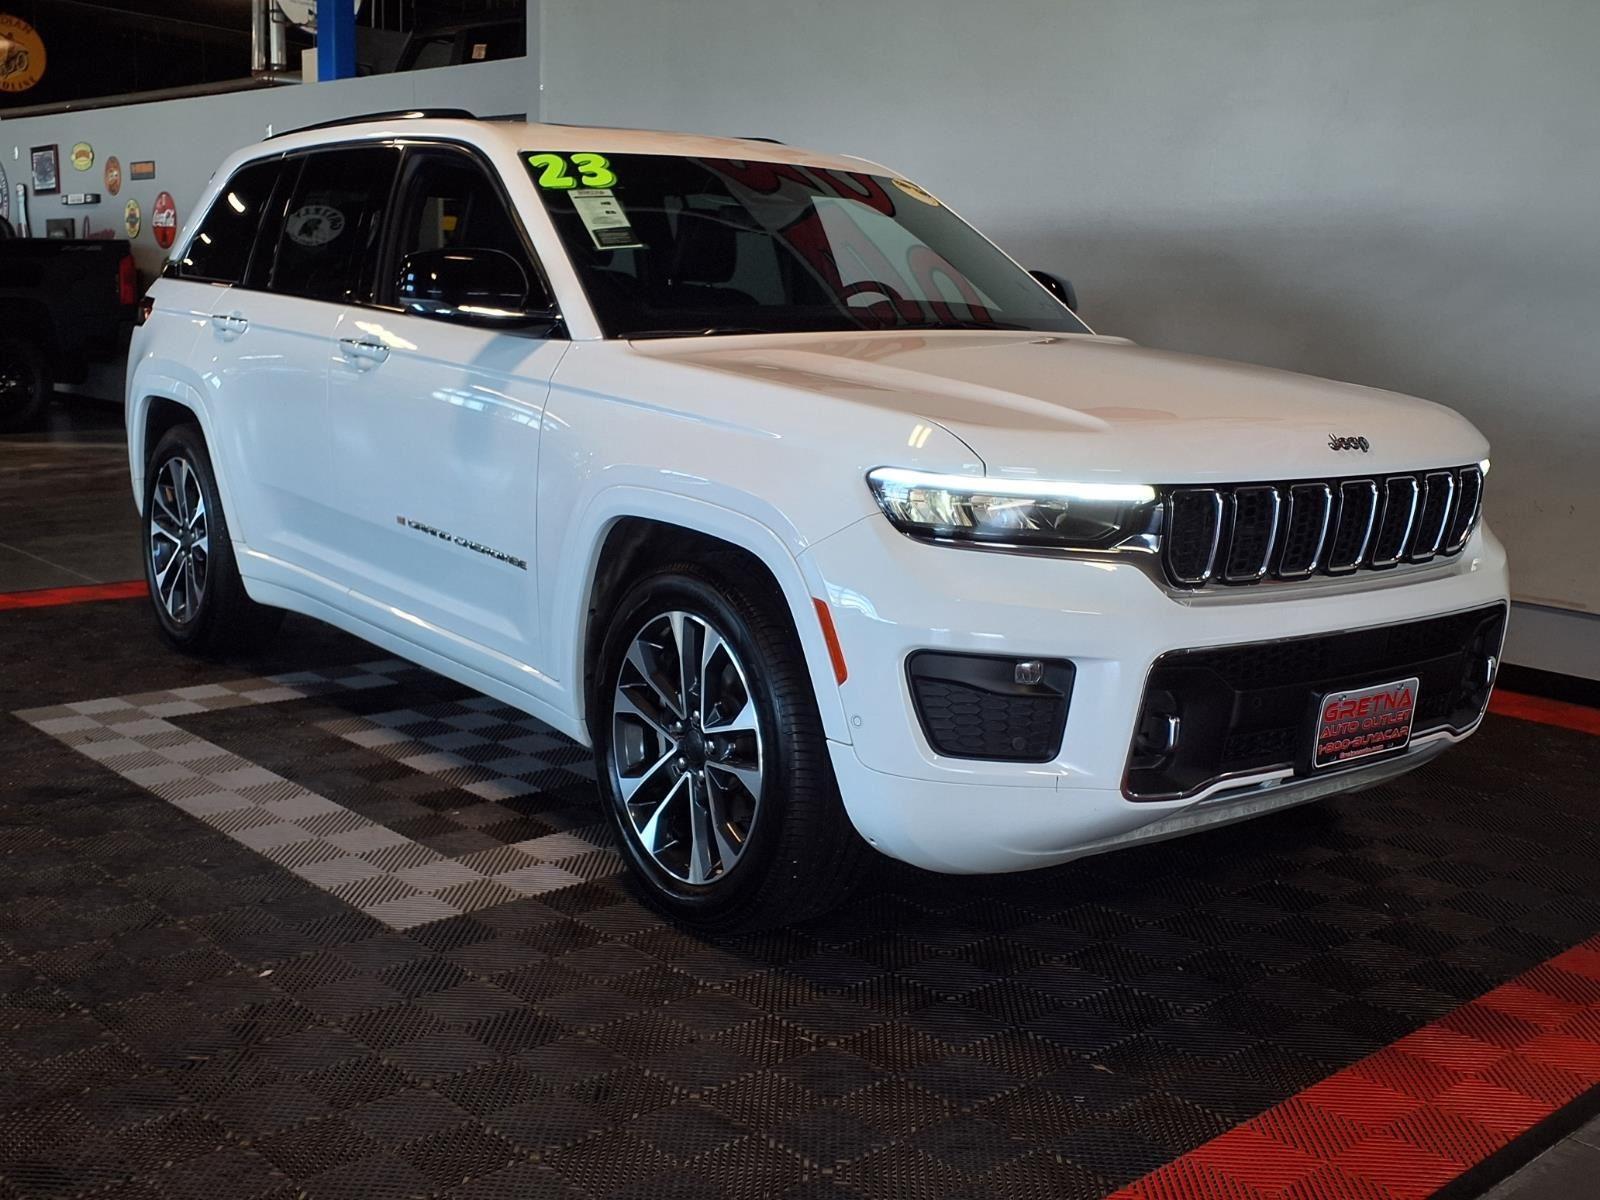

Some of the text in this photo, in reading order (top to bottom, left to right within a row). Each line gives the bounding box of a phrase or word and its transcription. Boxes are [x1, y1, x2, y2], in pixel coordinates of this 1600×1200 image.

[528, 153, 617, 188] 23
[1328, 433, 1370, 453] Jeep
[1324, 688, 1412, 722] GRETNA
[1320, 709, 1411, 739] AUTO OUTLET
